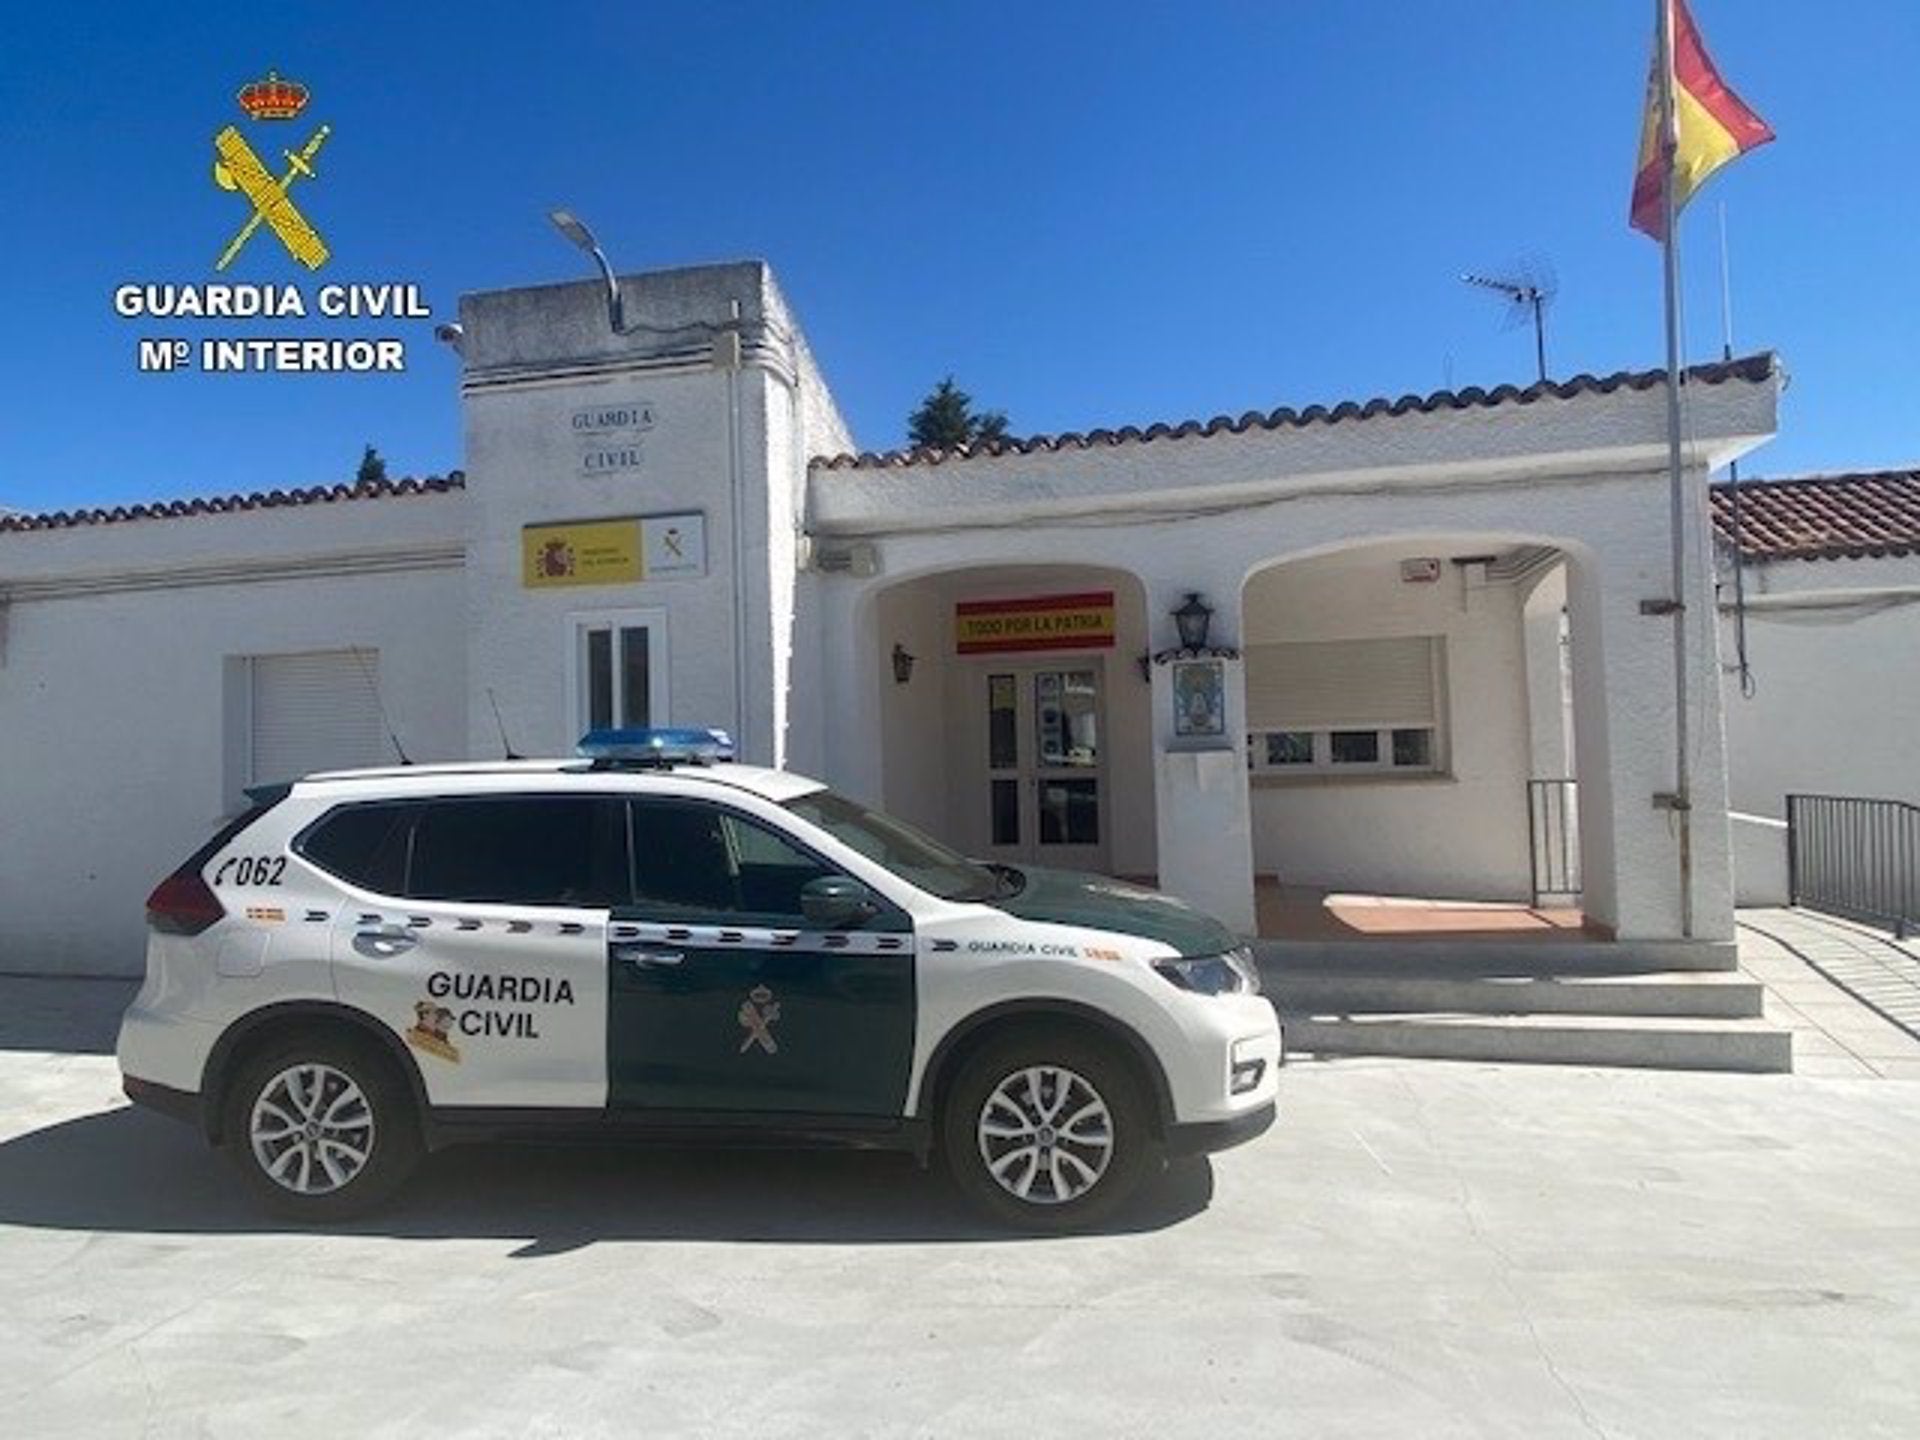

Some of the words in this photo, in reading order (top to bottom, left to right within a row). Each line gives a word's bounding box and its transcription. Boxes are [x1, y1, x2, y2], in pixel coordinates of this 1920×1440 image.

[572, 410, 653, 429] GUARDIA
[584, 450, 640, 468] CIVIL
[967, 619, 1003, 635] TODO
[1005, 617, 1033, 634] POR
[1034, 615, 1053, 631] LA
[1055, 613, 1103, 631] PATRIA
[236, 856, 286, 886] 062
[968, 941, 1035, 955] GUARDIA
[1042, 944, 1078, 958] CIVIL
[428, 971, 574, 1006] GUARDIA
[459, 1010, 539, 1039] CIVIL
